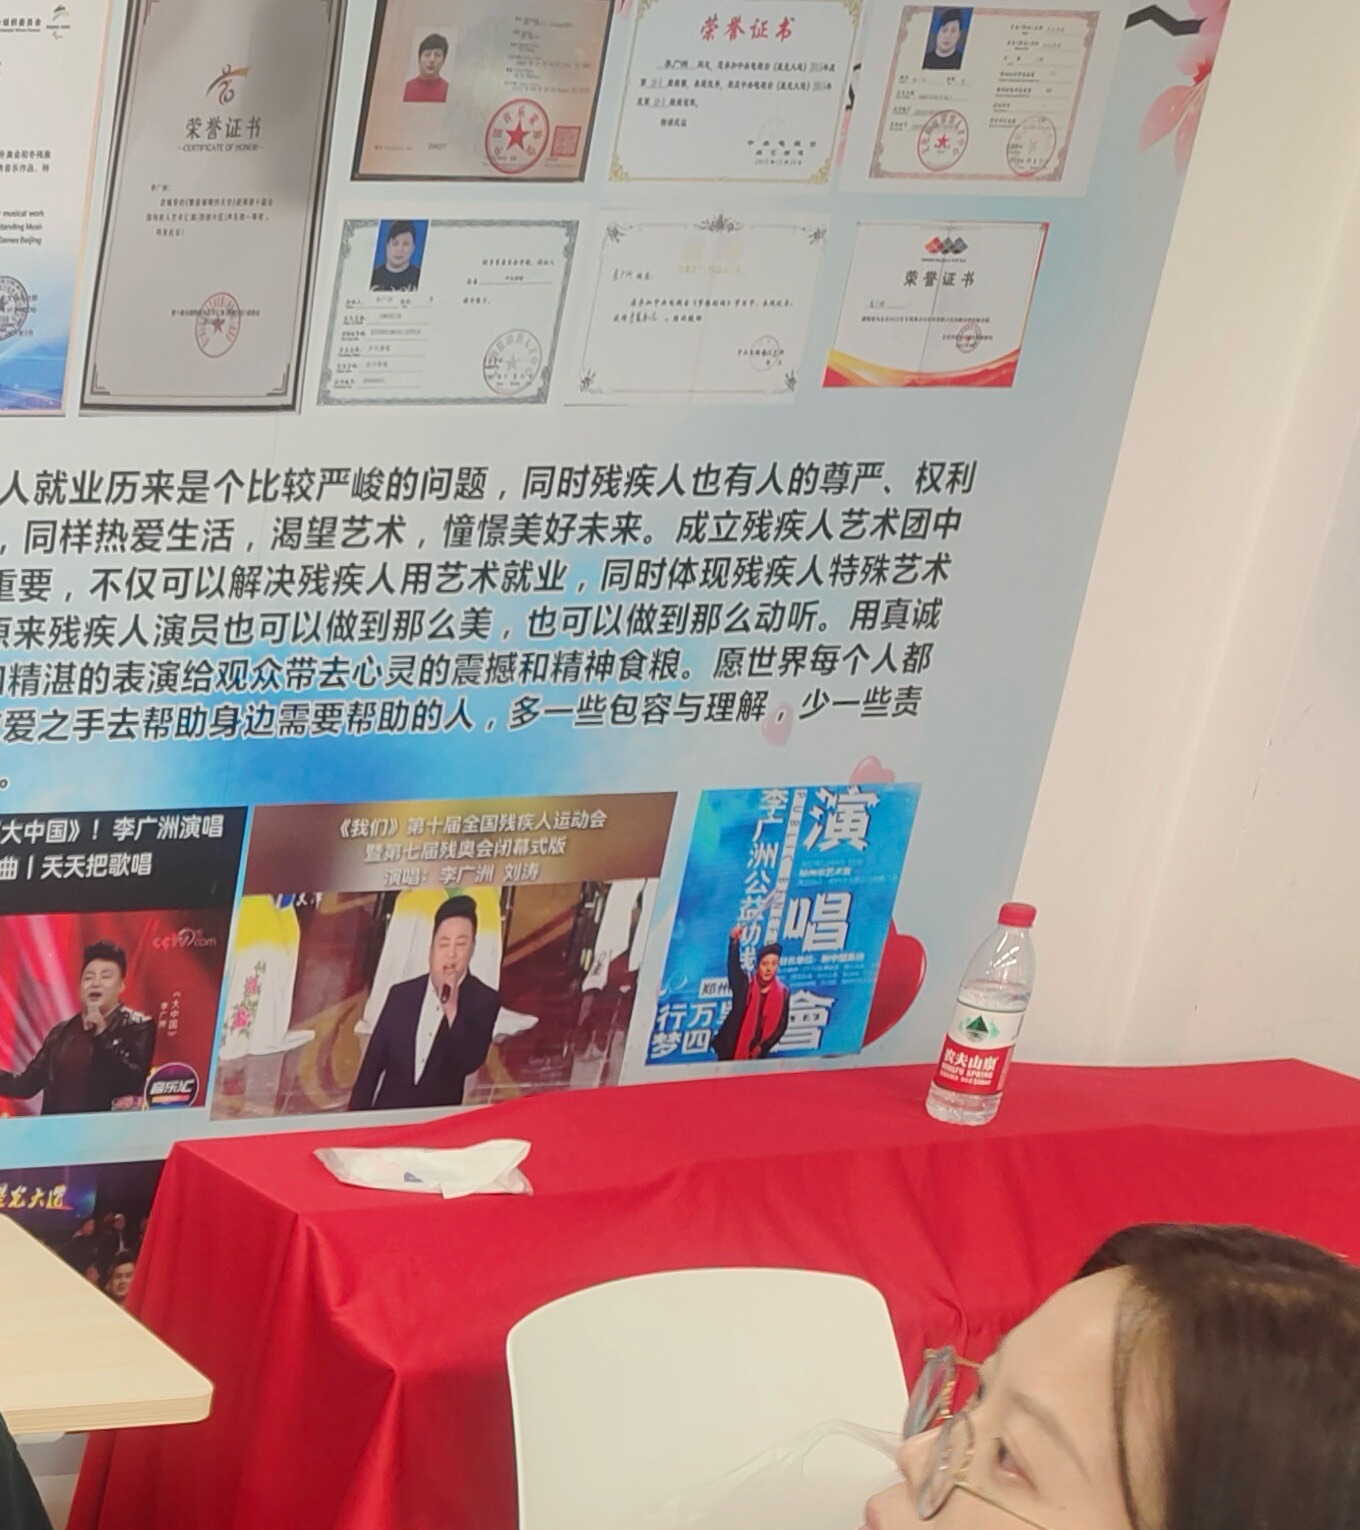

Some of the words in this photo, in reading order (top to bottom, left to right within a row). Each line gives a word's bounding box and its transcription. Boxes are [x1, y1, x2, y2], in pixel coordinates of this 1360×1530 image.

[700, 13, 795, 42] 荣誉证书
[185, 116, 262, 140] 荣誉证书
[903, 270, 975, 288] 荣誉证书
